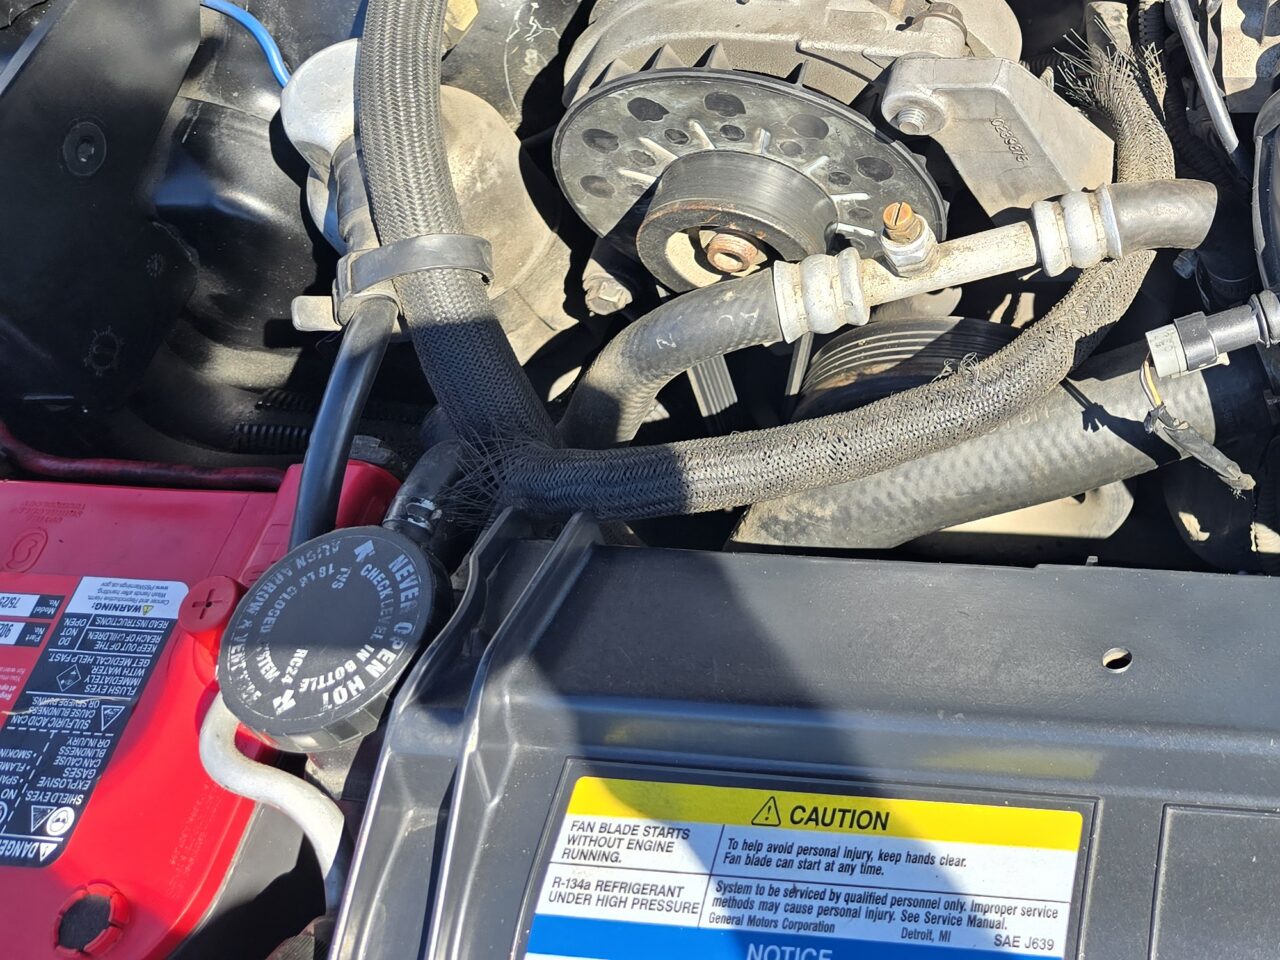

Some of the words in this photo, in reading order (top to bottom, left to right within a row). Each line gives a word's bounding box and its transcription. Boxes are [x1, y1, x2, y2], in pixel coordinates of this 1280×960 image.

[360, 564, 393, 599] CHECK
[33, 606, 56, 614] Model
[91, 602, 141, 613] WARNING:
[64, 617, 87, 627] OPEN.
[95, 617, 148, 628] INSTRUCTIONS.
[148, 619, 169, 629] READ
[61, 627, 78, 636] NOT
[87, 631, 125, 641] CHILDREN.
[58, 637, 71, 646] DO
[125, 633, 136, 642] OF
[136, 633, 162, 643] REACH
[94, 641, 110, 650] THE
[109, 642, 121, 650] OF
[120, 642, 137, 651] OUT
[136, 643, 158, 652] KEEP
[365, 621, 414, 679] OPEN
[48, 652, 71, 662] FAST.
[70, 654, 94, 662] HELP
[355, 644, 376, 662] IN
[95, 655, 133, 666] MEDICAL
[132, 658, 150, 667] GET
[255, 636, 282, 683] STEM
[91, 665, 121, 675] WATER.
[121, 667, 145, 676] WITH
[298, 658, 358, 693] BOTTLE
[83, 674, 142, 686] IMMEDIATELY
[84, 684, 106, 693] EYES
[105, 685, 138, 695] FLUSH
[320, 673, 366, 711] HOT
[89, 700, 100, 709] OR
[29, 706, 70, 716] BLINDNESS
[70, 708, 96, 718] CAUSE
[10, 715, 28, 724] CAN
[28, 716, 49, 727] ACID
[48, 718, 91, 730] SULFURIC
[66, 736, 98, 746] INJURY.
[98, 739, 111, 748] OR
[58, 746, 106, 757] BLINDNESS
[53, 756, 82, 766] CAUSE
[83, 758, 101, 767] CAN
[63, 767, 96, 778] GASES
[37, 776, 91, 790] EXPLOSIVE
[1, 788, 18, 799] NO
[25, 790, 50, 801] EYES.
[50, 792, 84, 805] SHIELD
[789, 805, 891, 831] CAUTION
[570, 821, 596, 833] FAN
[598, 822, 639, 836] BLADE
[642, 826, 691, 840] STARTS
[566, 834, 624, 849] WITHOUT
[626, 839, 675, 853] ENGINE
[561, 848, 622, 864] RUNNING.
[728, 838, 738, 849] To
[741, 839, 763, 854] help
[767, 841, 793, 854] avoid
[796, 844, 840, 860] personal
[843, 846, 873, 863] injury,
[877, 849, 901, 864] keep
[905, 851, 936, 865] hands
[939, 854, 967, 868] clear.
[723, 852, 741, 866] Fan
[744, 853, 773, 867] blade
[775, 858, 794, 869] can
[797, 857, 821, 871] start
[824, 861, 834, 871] at
[837, 863, 855, 876] any
[859, 861, 885, 876] time.
[552, 876, 592, 891] R-134a
[594, 880, 685, 898] REFRIGERANT
[548, 892, 592, 906] UNDER
[595, 895, 627, 909] HIGH
[630, 898, 700, 914] PRESSURE
[715, 880, 752, 898] System
[755, 884, 765, 897] to
[767, 885, 780, 897] be
[782, 887, 826, 902] serviced
[828, 890, 841, 904] by
[843, 891, 882, 907] qualified
[890, 894, 940, 911] personnel
[943, 899, 967, 914] only.
[970, 901, 1017, 918] Improper
[1020, 906, 1059, 919] service
[712, 897, 754, 911] methods
[757, 901, 779, 915] may
[783, 904, 814, 916] cause
[817, 906, 861, 922] personal
[865, 906, 896, 923] injury.
[900, 909, 921, 923] See
[924, 911, 963, 927] Service
[966, 914, 1008, 930] Manual.
[708, 913, 744, 926] General
[747, 916, 779, 929] Motors
[782, 918, 835, 935] Corporation
[901, 927, 935, 942] Detroit,
[938, 930, 951, 943] MI
[993, 934, 1021, 948] SAE
[1024, 937, 1055, 951] J639
